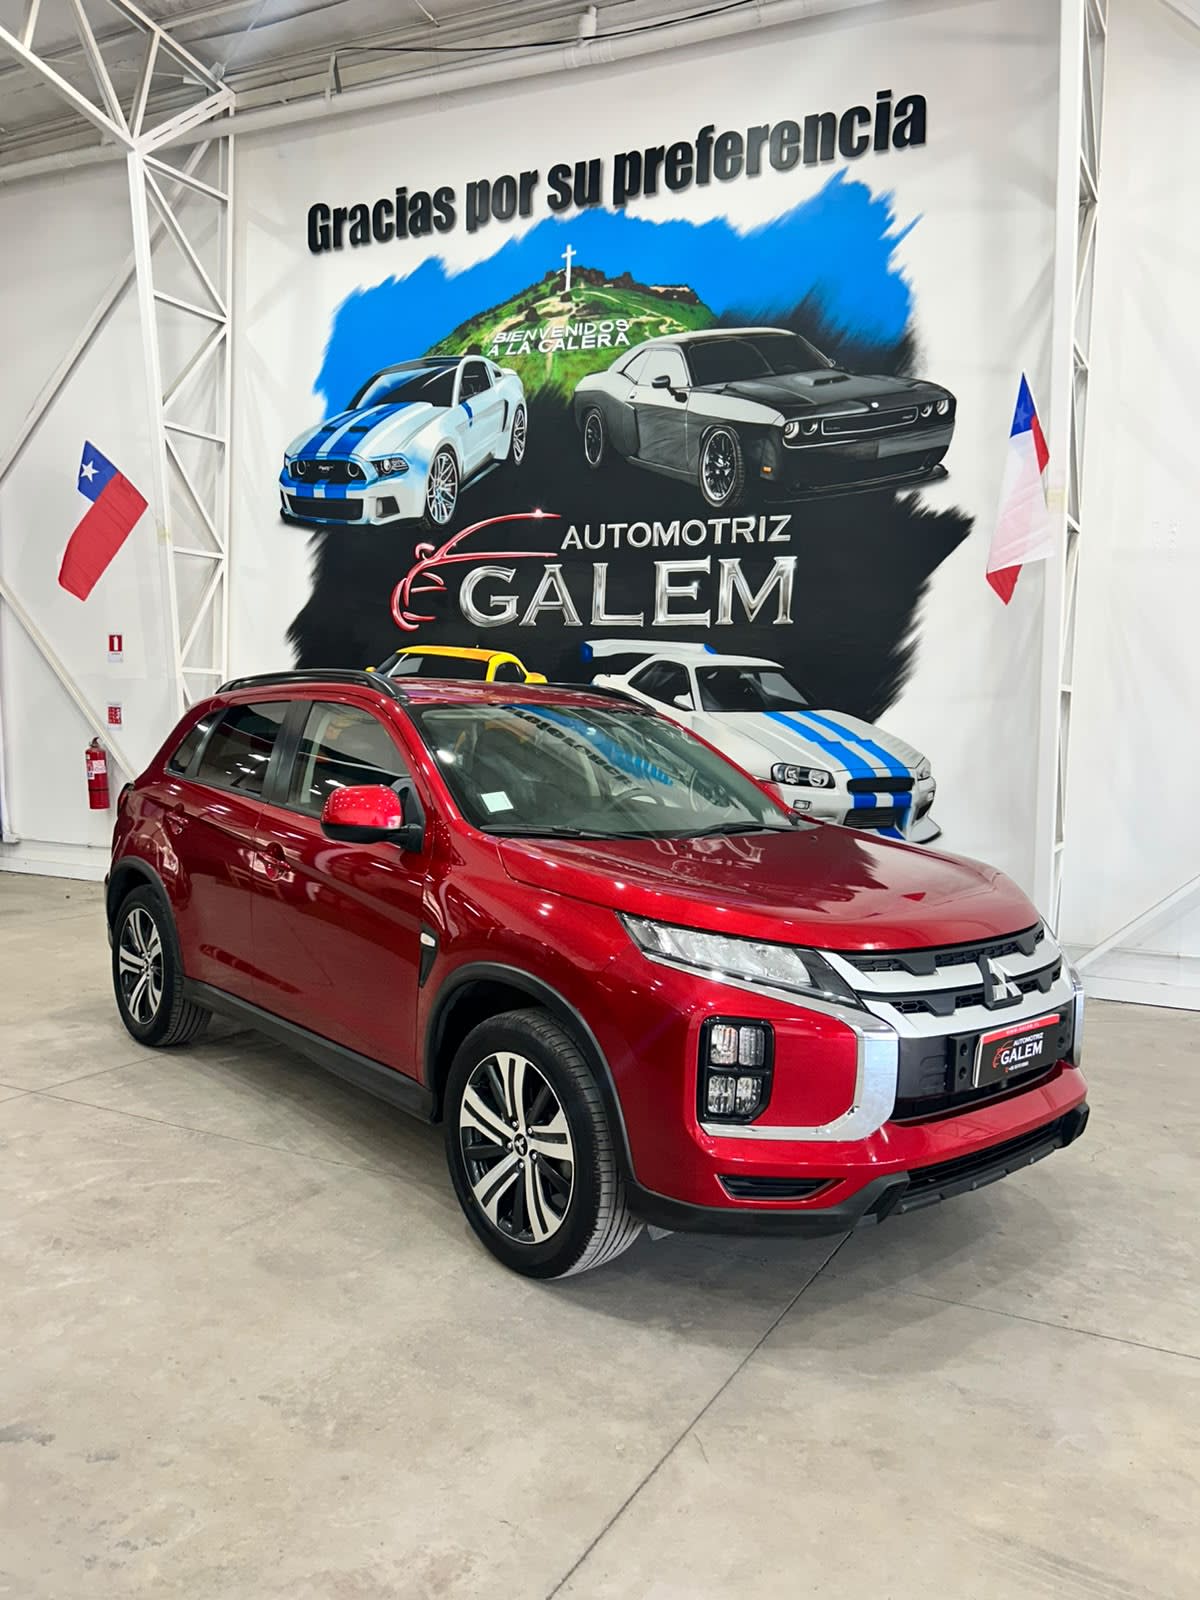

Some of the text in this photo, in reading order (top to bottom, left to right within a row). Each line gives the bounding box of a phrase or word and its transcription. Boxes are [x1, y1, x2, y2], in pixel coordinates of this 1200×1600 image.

[307, 88, 928, 255] Gracias por su preferencia
[487, 332, 631, 357] A LA CALERA
[493, 319, 630, 344] BIENVENIDOS
[561, 514, 793, 550] AUTOMOTRIZ
[458, 555, 799, 628] GALEM
[1001, 1040, 1043, 1065] GALEM
